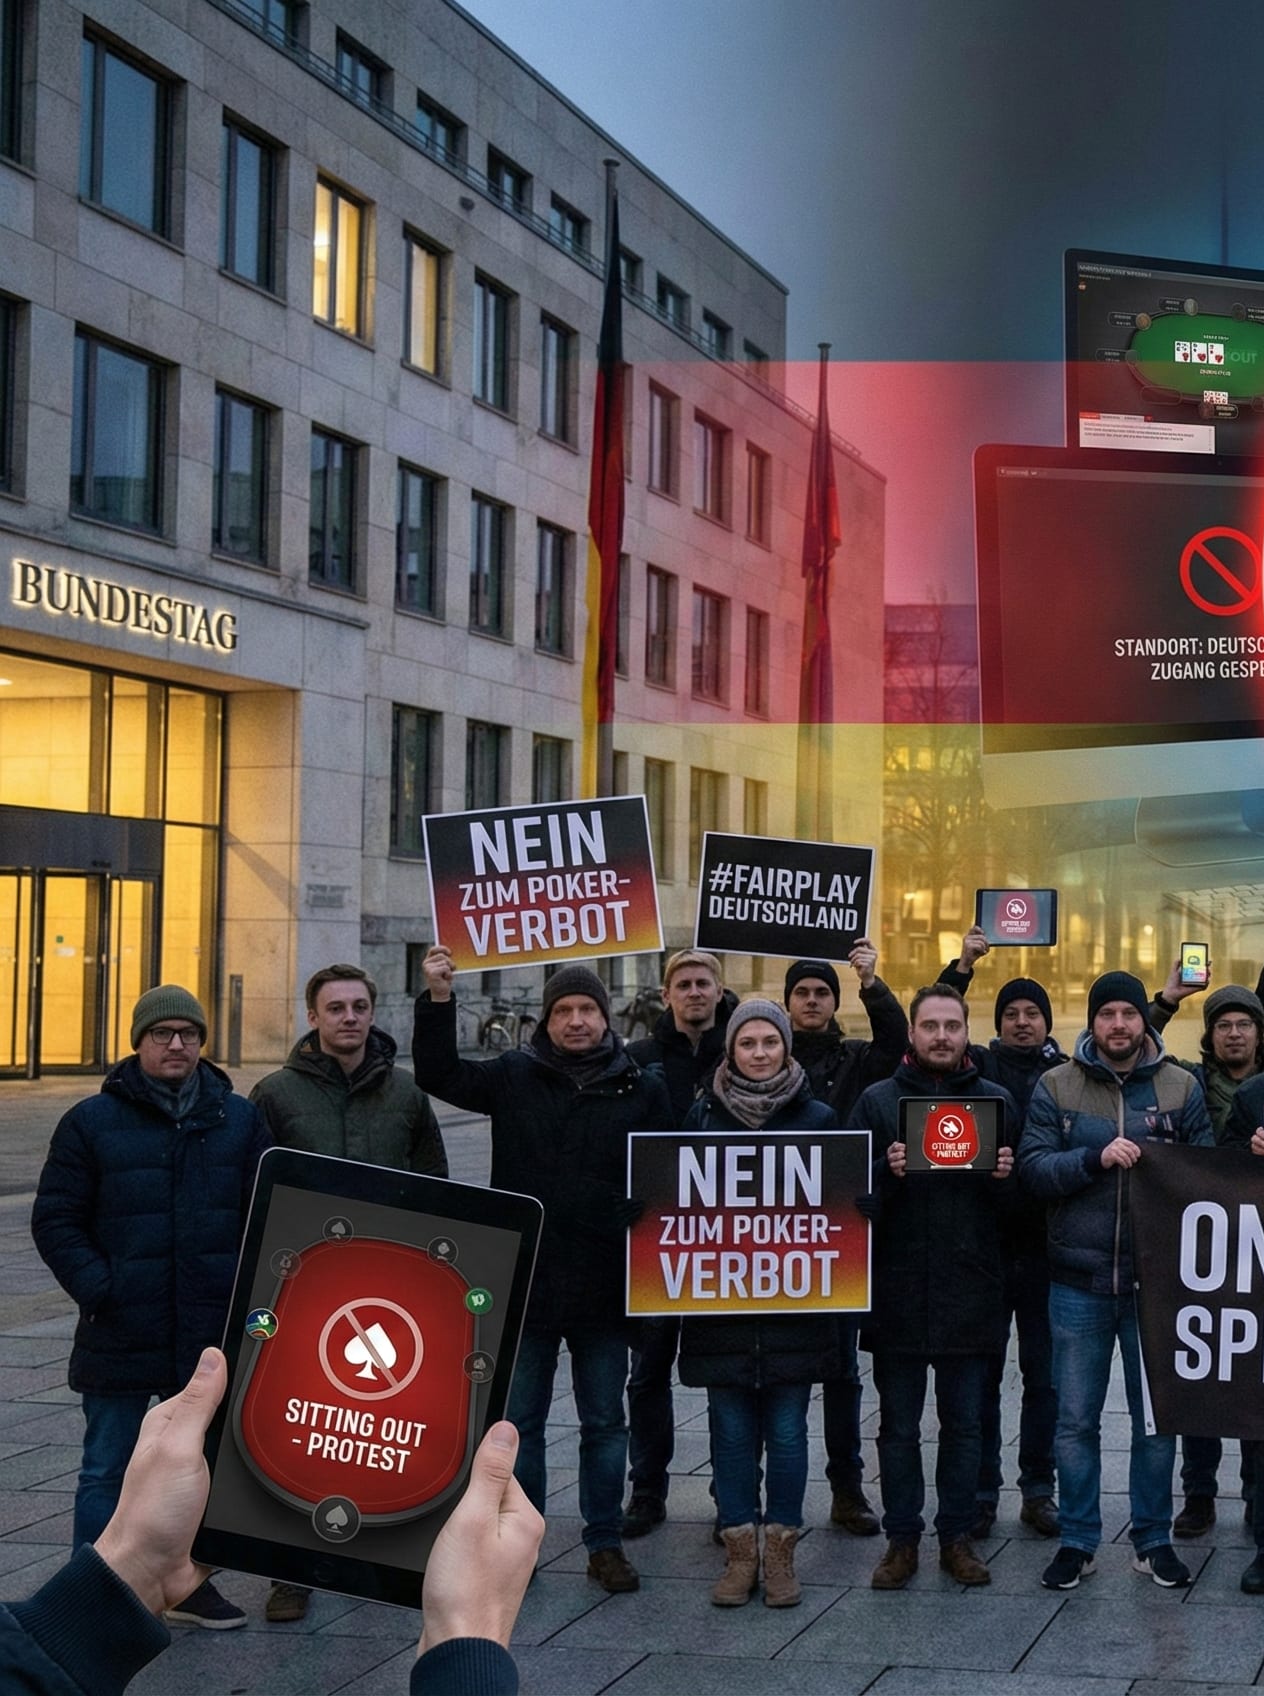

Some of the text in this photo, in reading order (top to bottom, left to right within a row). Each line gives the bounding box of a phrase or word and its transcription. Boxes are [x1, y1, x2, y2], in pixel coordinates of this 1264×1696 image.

[14, 560, 238, 650] BUNDESTAG
[1114, 637, 1203, 657] STANDORT:
[1150, 660, 1215, 680] ZUGANG
[469, 810, 607, 876] NEIN
[458, 869, 631, 911] ZUM POKER-
[708, 862, 862, 905] #FAIRPLAY
[463, 900, 630, 957] VERBOT
[708, 897, 858, 932] DEUTSCHLAND
[678, 1145, 822, 1208] NEIN
[659, 1214, 842, 1245] ZUM POKER-
[659, 1250, 839, 1299] VERBOT
[285, 1398, 427, 1448] SITTING OUT
[306, 1431, 411, 1474] PROTEST
